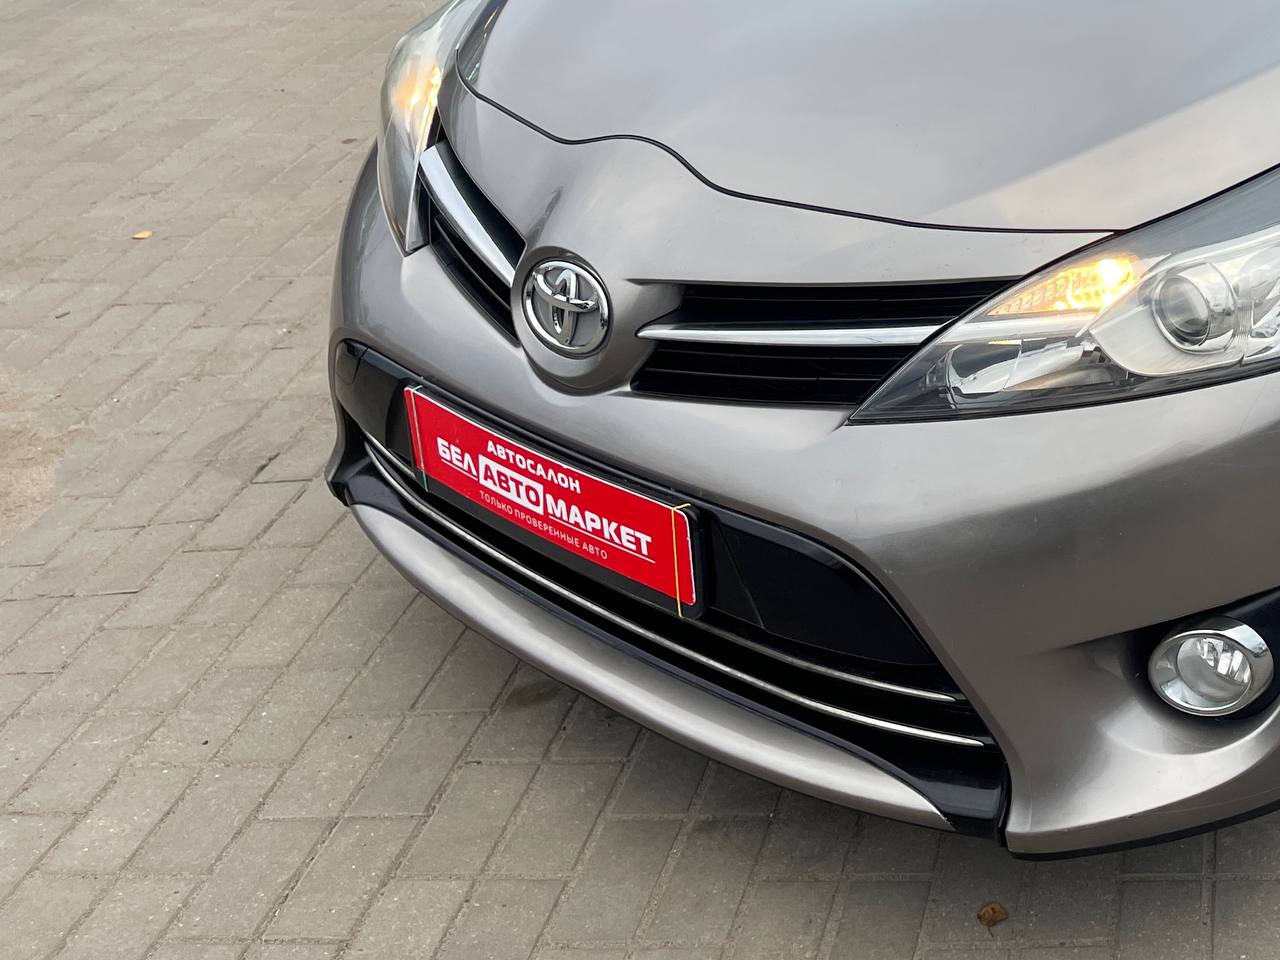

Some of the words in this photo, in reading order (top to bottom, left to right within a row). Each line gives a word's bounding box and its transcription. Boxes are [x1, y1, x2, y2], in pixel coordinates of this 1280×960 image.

[436, 436, 478, 477] БЕЛ
[483, 463, 541, 507] АВТО
[545, 493, 652, 556] МАРКЕТ
[486, 439, 581, 494] АВТОСАЛОН
[479, 490, 513, 516] ТОЛЬКО
[514, 509, 580, 548] ПРОВЕРЕННЫЕ
[582, 543, 608, 560] АВТО
